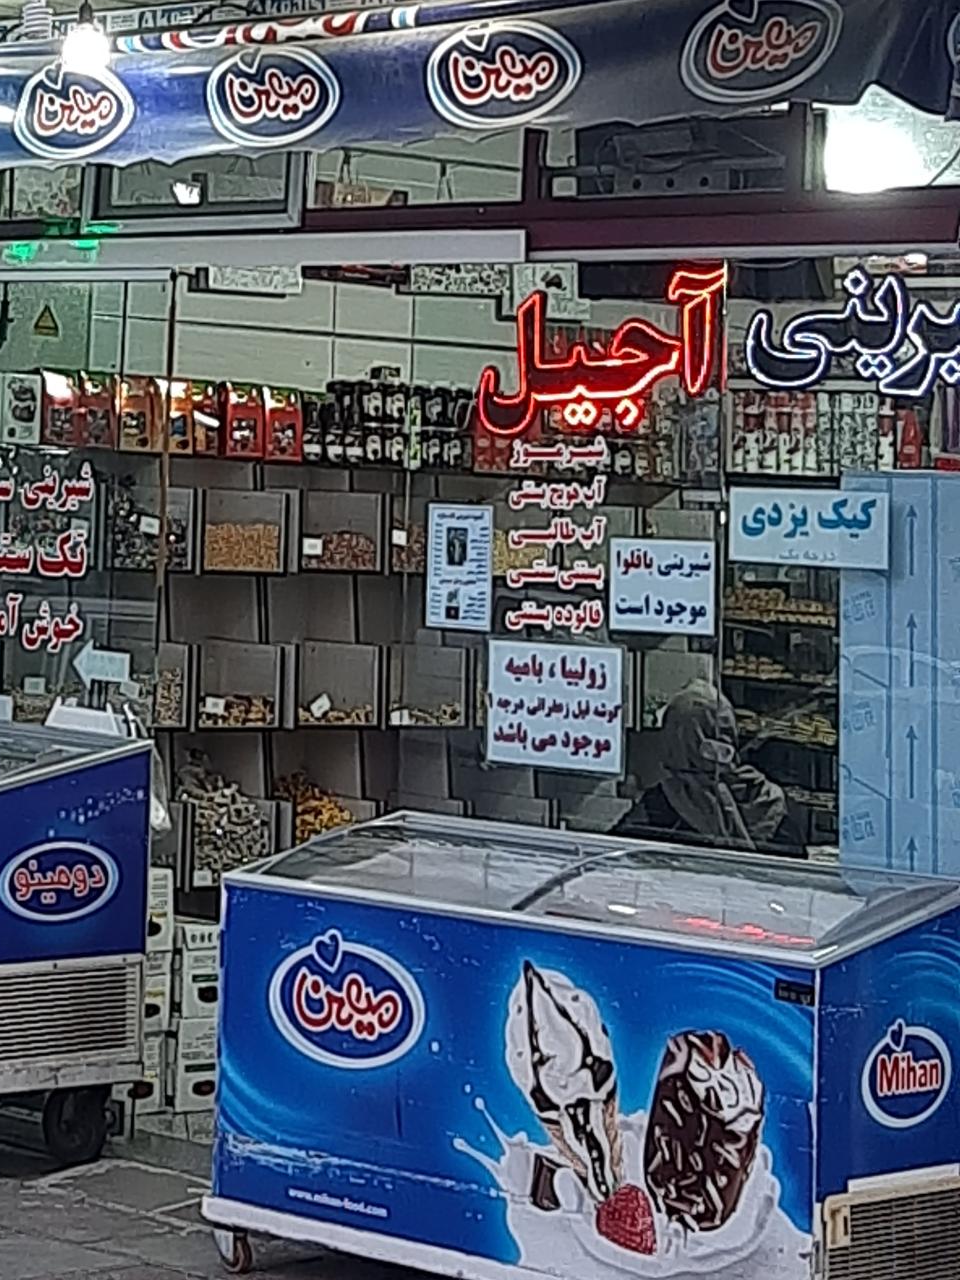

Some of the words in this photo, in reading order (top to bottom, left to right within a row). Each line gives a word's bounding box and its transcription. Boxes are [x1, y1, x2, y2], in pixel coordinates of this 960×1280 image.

[707, 16, 821, 79] میهن
[450, 46, 558, 105] میهن
[36, 86, 116, 137] میهن
[226, 68, 320, 122] میهن
[746, 267, 960, 396] یرینی
[478, 267, 726, 435] آجیل
[509, 481, 547, 510] بستنی
[549, 484, 581, 510] هویج
[582, 476, 607, 509] آب
[509, 517, 576, 550] طالبی
[579, 516, 607, 549] آب
[740, 500, 809, 539] یزدی
[816, 498, 878, 539] کیک
[37, 529, 88, 577] تک
[616, 547, 654, 575] باقلوا
[657, 551, 711, 577] شیرینی
[507, 559, 558, 588] سنتی
[559, 560, 605, 590] بستنی
[505, 601, 552, 630] بستنی
[554, 598, 605, 633] فالوده
[615, 593, 650, 616] است
[656, 599, 707, 626] موجود
[21, 600, 83, 652] خوش
[505, 654, 543, 683] بامیه
[496, 696, 525, 715] درجه
[493, 721, 528, 750] باشد
[531, 733, 558, 752] می
[561, 730, 611, 759] موجود
[14, 859, 105, 904] دومینو
[292, 966, 403, 1041] میهن
[876, 1051, 942, 1097] Mihan
